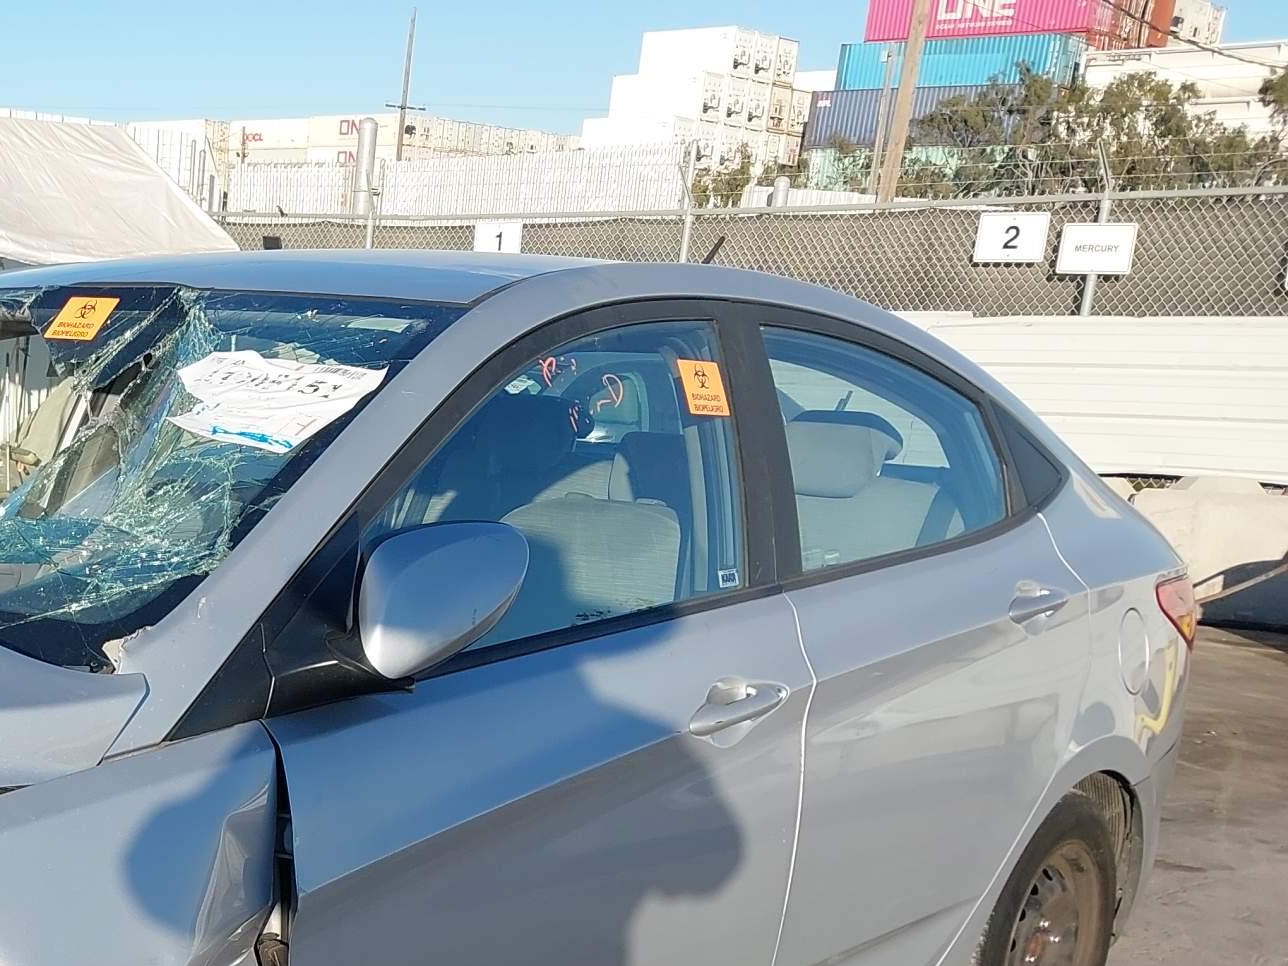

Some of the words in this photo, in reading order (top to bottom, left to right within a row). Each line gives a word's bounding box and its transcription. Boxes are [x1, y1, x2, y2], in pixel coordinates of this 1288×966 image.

[495, 231, 503, 252] 1
[1001, 225, 1021, 250] 2
[1074, 244, 1120, 253] MERCURY
